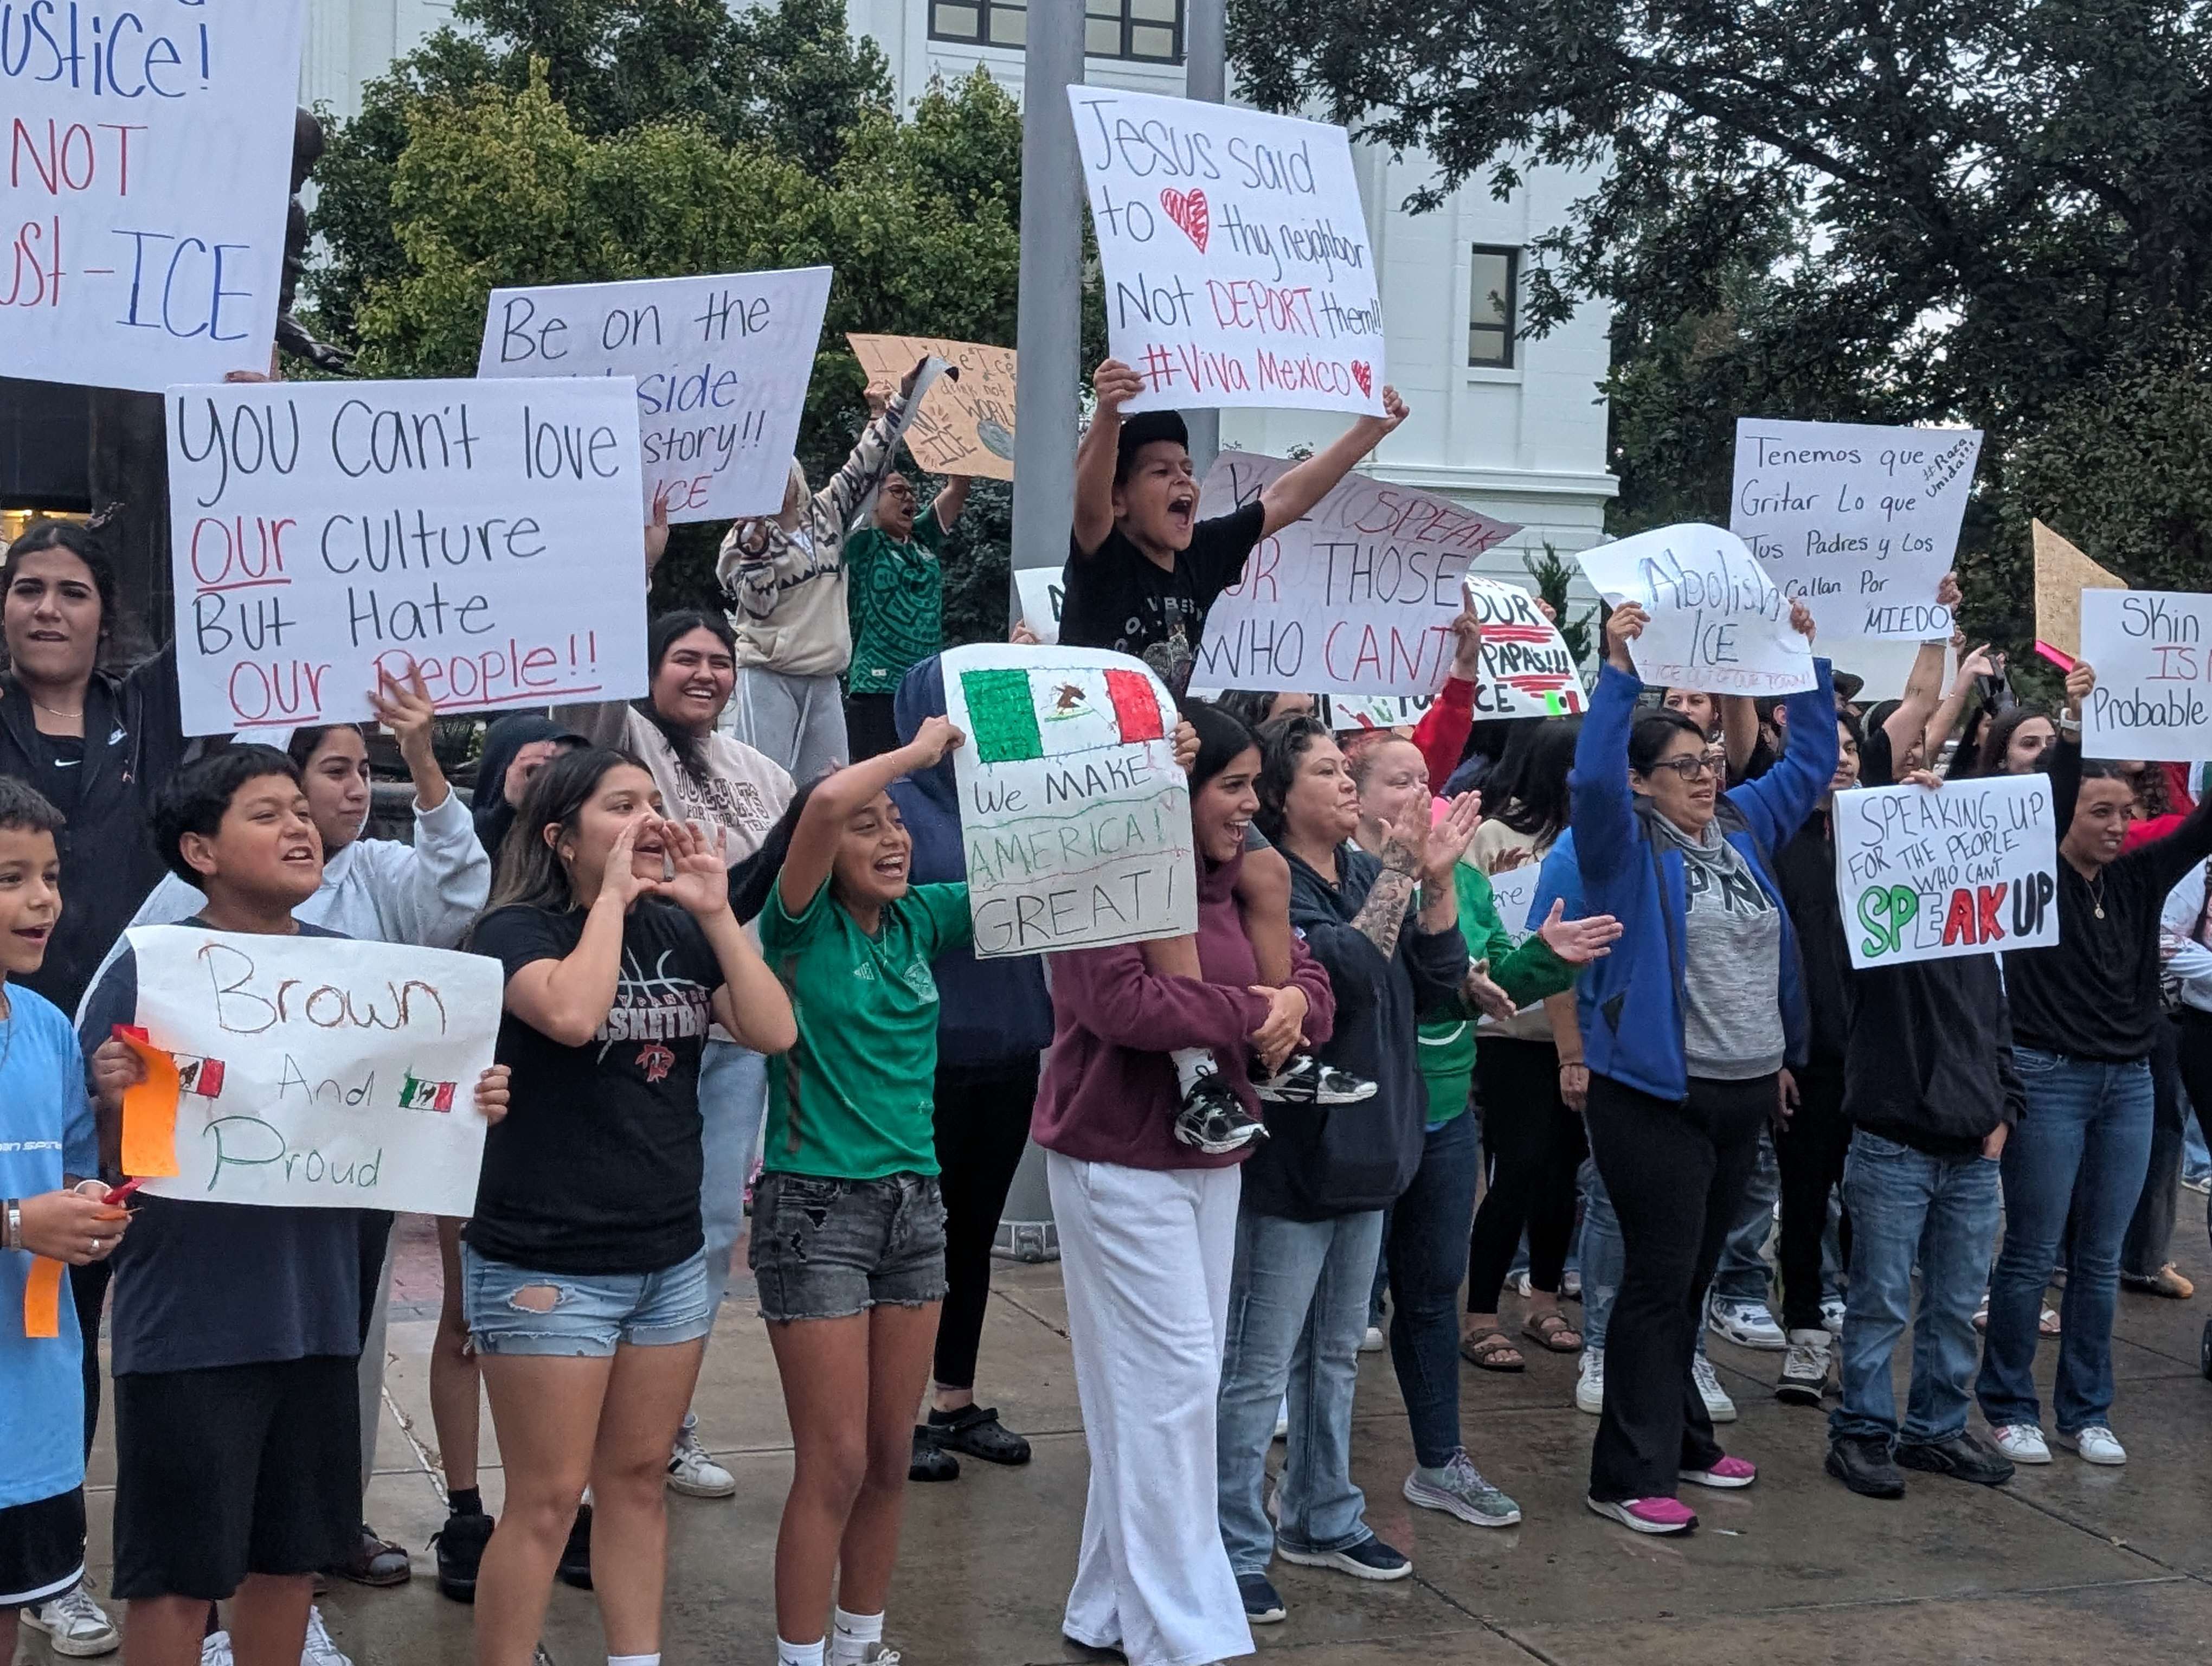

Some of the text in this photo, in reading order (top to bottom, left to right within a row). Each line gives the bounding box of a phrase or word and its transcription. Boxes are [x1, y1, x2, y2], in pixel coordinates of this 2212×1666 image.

[11, 118, 148, 196] NOT
[1098, 184, 1364, 283] to thy neighbor
[501, 290, 770, 362] Be on the
[1117, 272, 1384, 339] Not DEPORT them!!
[636, 363, 737, 415] side
[1137, 343, 1350, 396] #Viva Mexico
[643, 409, 766, 472] story!!
[953, 395, 1017, 427] WORL
[524, 406, 619, 480] love
[921, 424, 978, 466] ICE
[1745, 436, 1925, 477] Tenemos que
[1354, 490, 1509, 551] SPEAK
[1740, 479, 1917, 522] Gritar Lo que
[1741, 529, 1934, 560] Tus Padres y Los
[1314, 542, 1467, 607] THOSE
[1860, 569, 1891, 595] Por
[348, 582, 496, 647] Hate
[1689, 608, 1739, 667] ICE
[1864, 604, 1950, 634] MIEDO
[1198, 619, 1304, 678] WHO
[2146, 645, 2198, 681] IS
[1474, 683, 1516, 713] CE
[2093, 687, 2209, 732] Probable
[974, 754, 1151, 815] We MAKE
[970, 807, 1167, 886] AMERICA!
[1861, 791, 2044, 847] SPEAKING UP
[1848, 829, 2020, 885] FOR THE PEOPLE
[1912, 865, 1959, 894] WHO
[974, 865, 1174, 953] GREAT!
[1856, 882, 2009, 959] SPEAK
[2011, 870, 2055, 938] UP
[198, 943, 446, 1035] Brown
[277, 1053, 375, 1107] And
[203, 1115, 383, 1192] Proud
